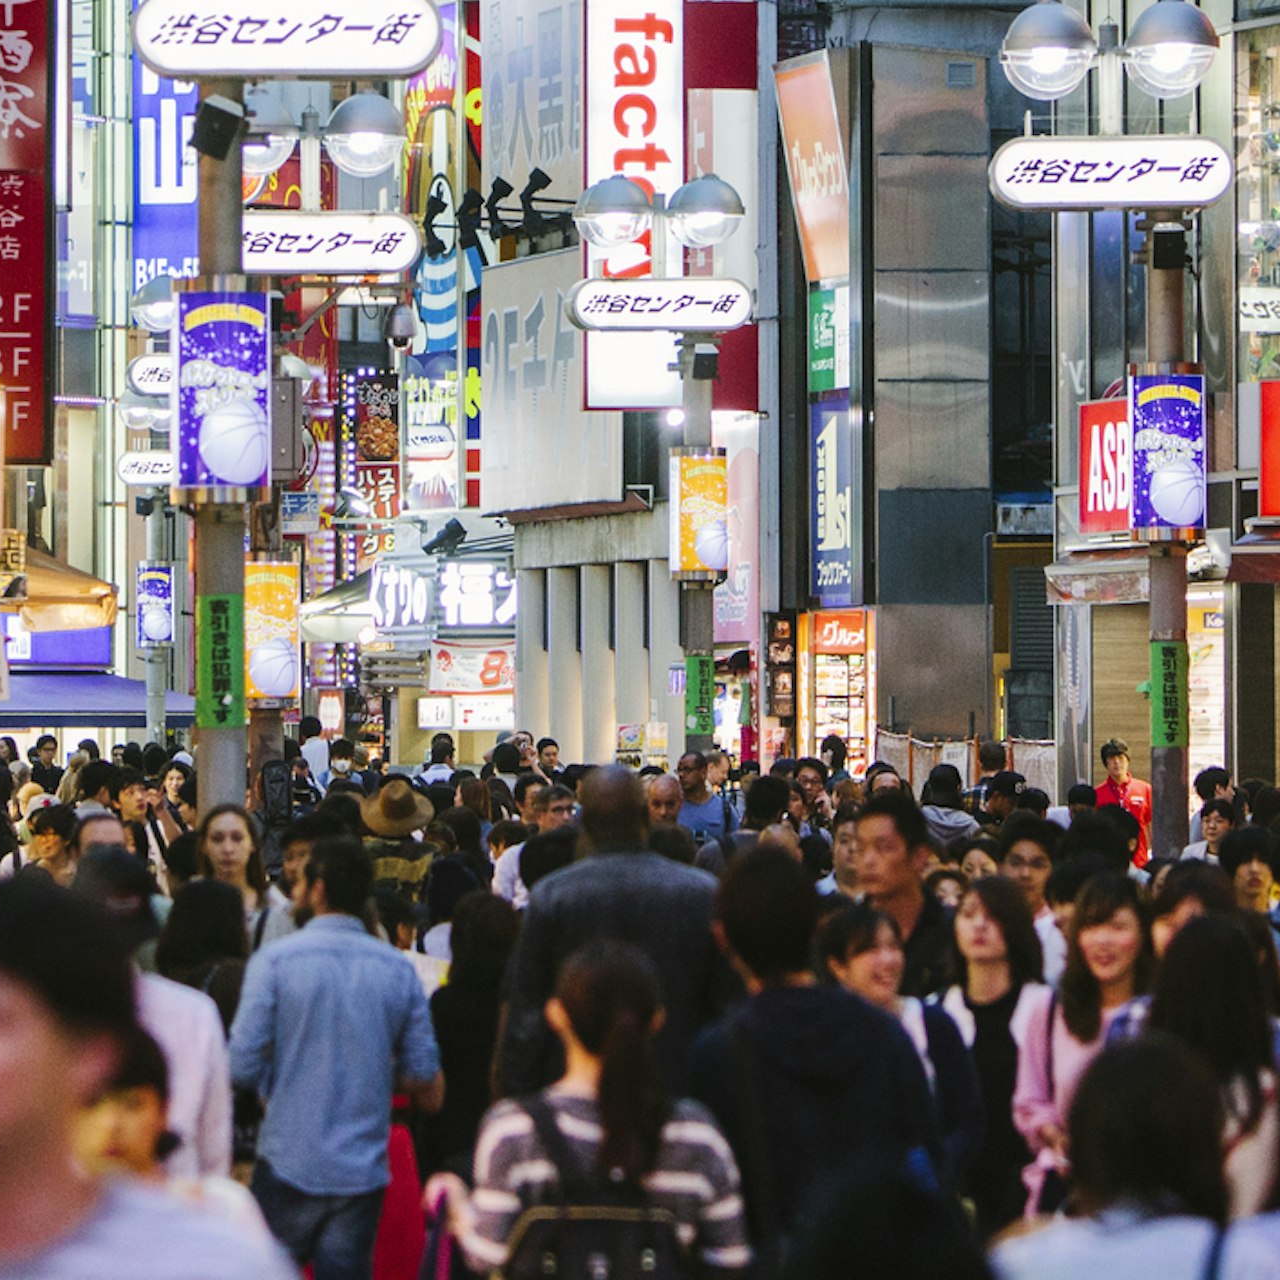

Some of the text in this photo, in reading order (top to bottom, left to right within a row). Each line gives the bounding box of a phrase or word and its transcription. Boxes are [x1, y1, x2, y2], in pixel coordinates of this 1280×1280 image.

[149, 13, 423, 46] 渋谷センター街
[603, 12, 674, 279] facty
[1006, 156, 1219, 185] 渋谷センター街
[583, 293, 742, 314] 渋谷センター街
[11, 401, 32, 431] F
[823, 621, 865, 646] グルメ
